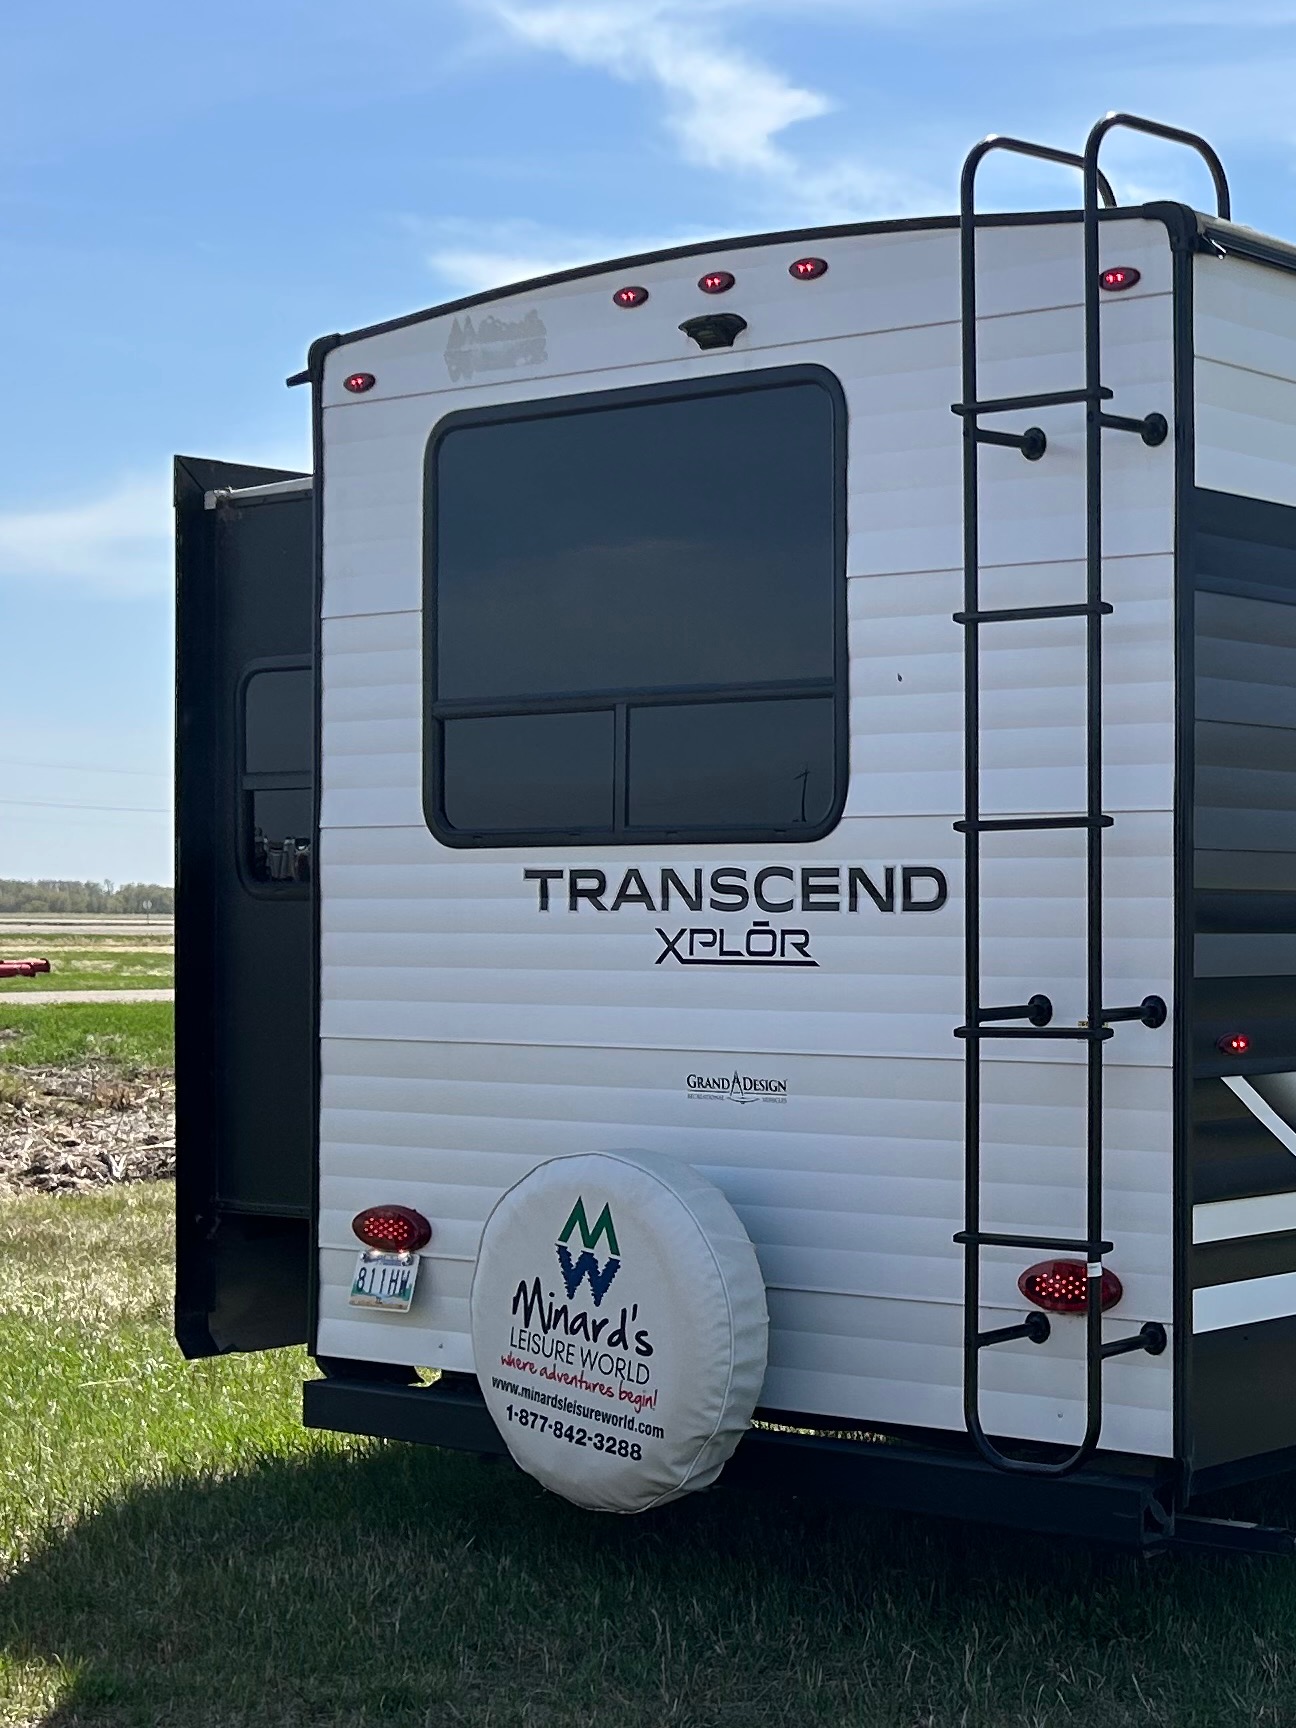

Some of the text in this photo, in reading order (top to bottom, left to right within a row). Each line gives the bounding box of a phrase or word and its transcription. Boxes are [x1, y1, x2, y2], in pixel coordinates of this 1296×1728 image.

[523, 865, 949, 914] TRANSCEND
[686, 1073, 787, 1093] GRAND DESIGN
[512, 1276, 654, 1357] Minard's
[501, 1350, 659, 1414] where adventures begin!
[510, 1326, 650, 1385] LEISURE WORLD
[491, 1376, 665, 1440] www.minardsleisureworld.com
[506, 1404, 642, 1461] 1-877-842-3288
